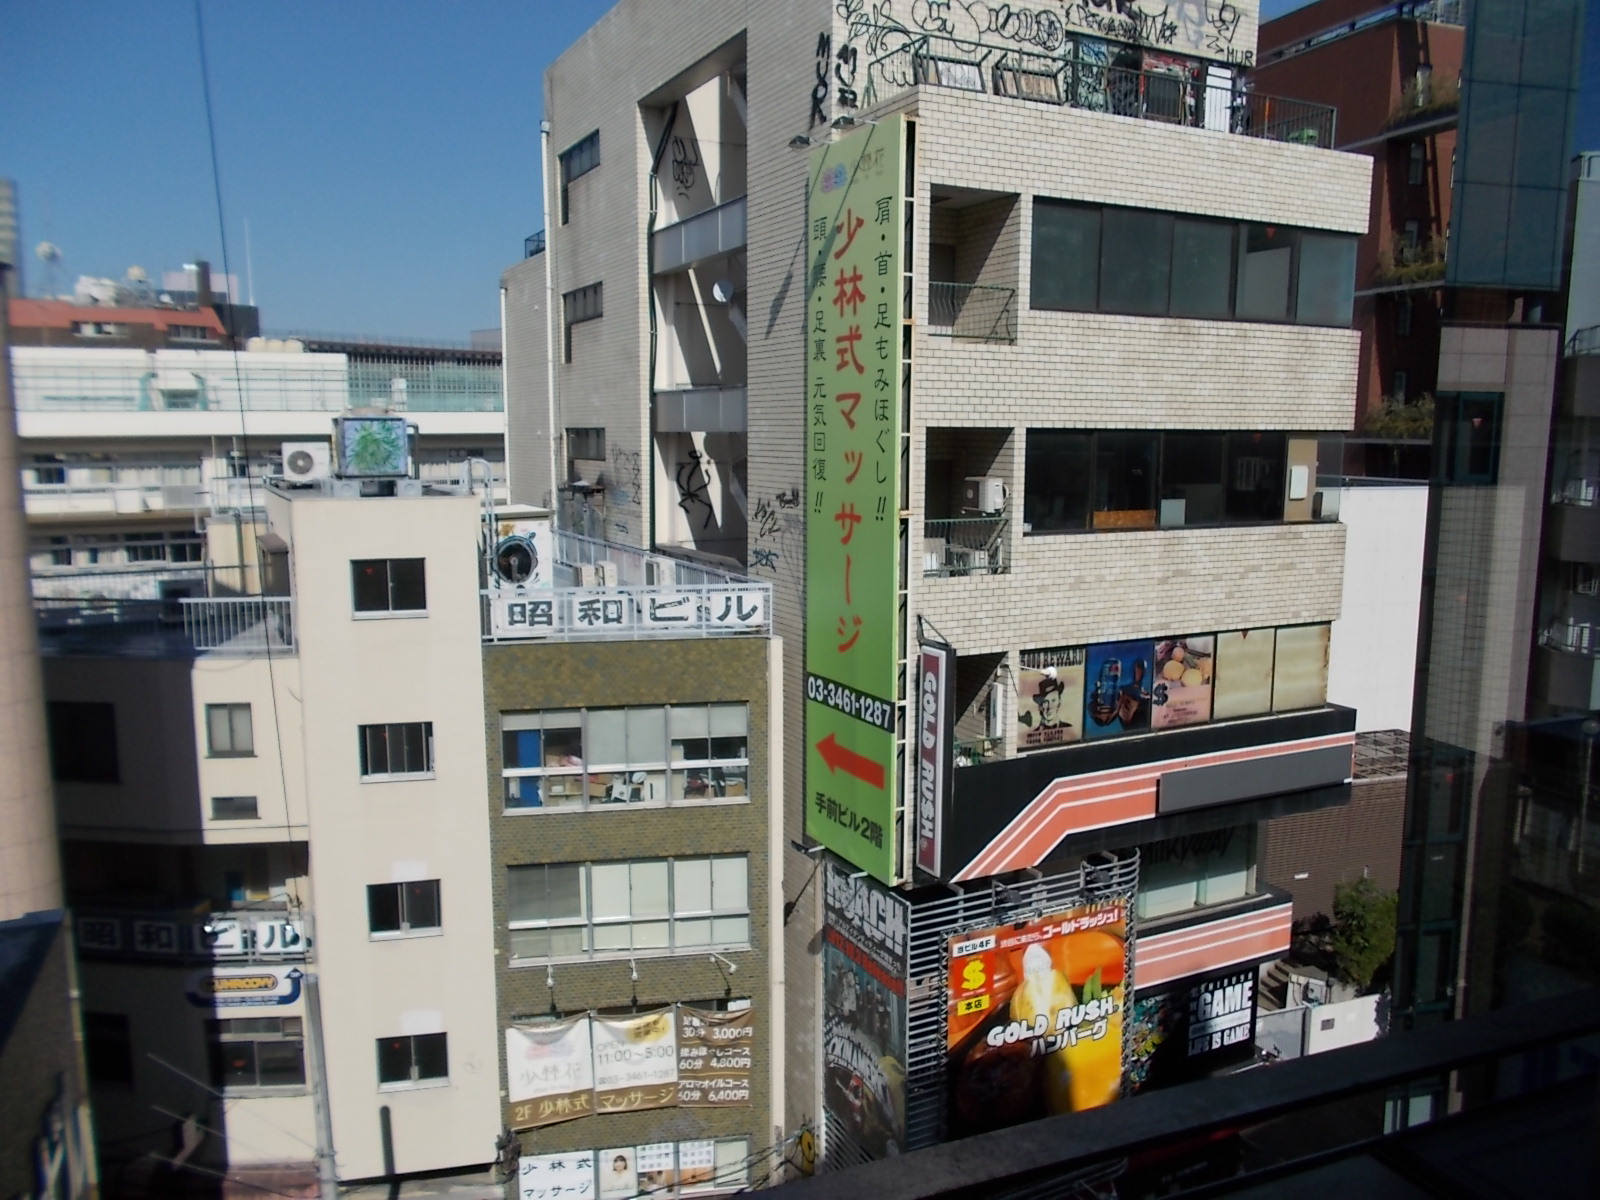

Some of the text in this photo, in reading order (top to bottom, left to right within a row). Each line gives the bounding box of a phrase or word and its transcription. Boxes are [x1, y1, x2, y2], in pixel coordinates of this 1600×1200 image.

[833, 207, 867, 653] 少林式マッサージ
[508, 595, 759, 627] 昭和ビル
[807, 675, 892, 729] 03-3461-1287
[922, 671, 937, 749] GOLD
[815, 791, 884, 850] 手前ビル2階
[1197, 980, 1253, 1022] GAME
[986, 1013, 1049, 1047] GOLD
[1030, 1018, 1108, 1058] ハンバーグ
[1211, 1030, 1222, 1050] IS
[1223, 1022, 1251, 1047] GAME
[514, 1093, 590, 1121] 2F 少林式
[600, 1086, 675, 1110] マッサージ
[520, 1157, 593, 1176] 少林式
[523, 1178, 592, 1199] マッサージ
